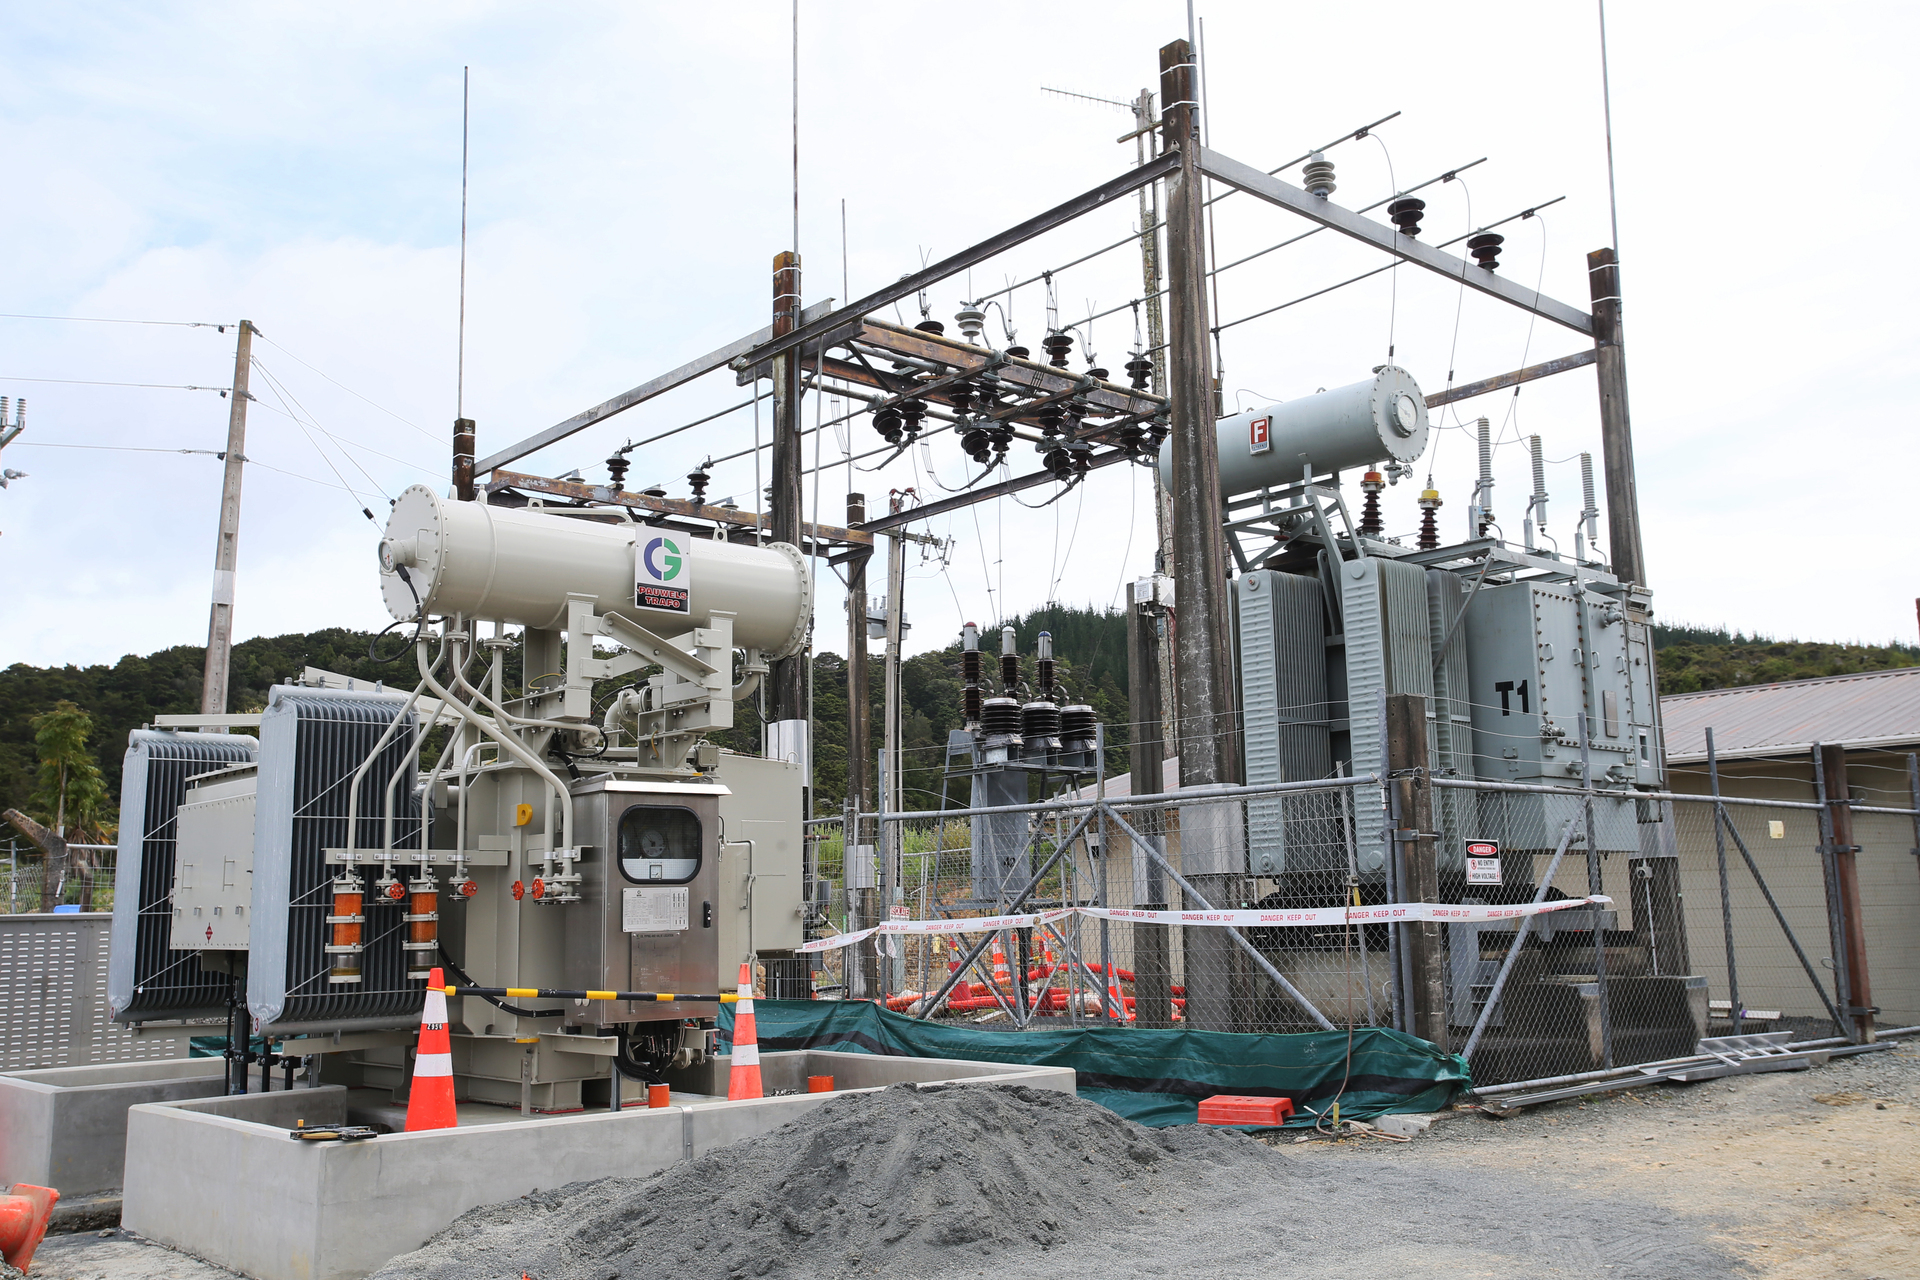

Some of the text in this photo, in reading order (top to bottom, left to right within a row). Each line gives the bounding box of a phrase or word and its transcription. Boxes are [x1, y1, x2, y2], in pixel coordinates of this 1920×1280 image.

[1254, 421, 1265, 443] F
[639, 587, 687, 600] PAUWELS
[646, 597, 680, 608] TRAFO
[1495, 679, 1529, 716] T1
[1109, 909, 1129, 917] DANGER
[1181, 913, 1204, 921] DANGER
[1223, 914, 1235, 922] OUT
[1260, 914, 1284, 922] DANGER
[1304, 913, 1317, 921] OUT
[1373, 910, 1389, 918] KEEP
[1393, 909, 1406, 917] OUT
[1433, 909, 1448, 917] DANGER
[1487, 910, 1502, 918] DANGER
[982, 919, 1000, 927] DANGER
